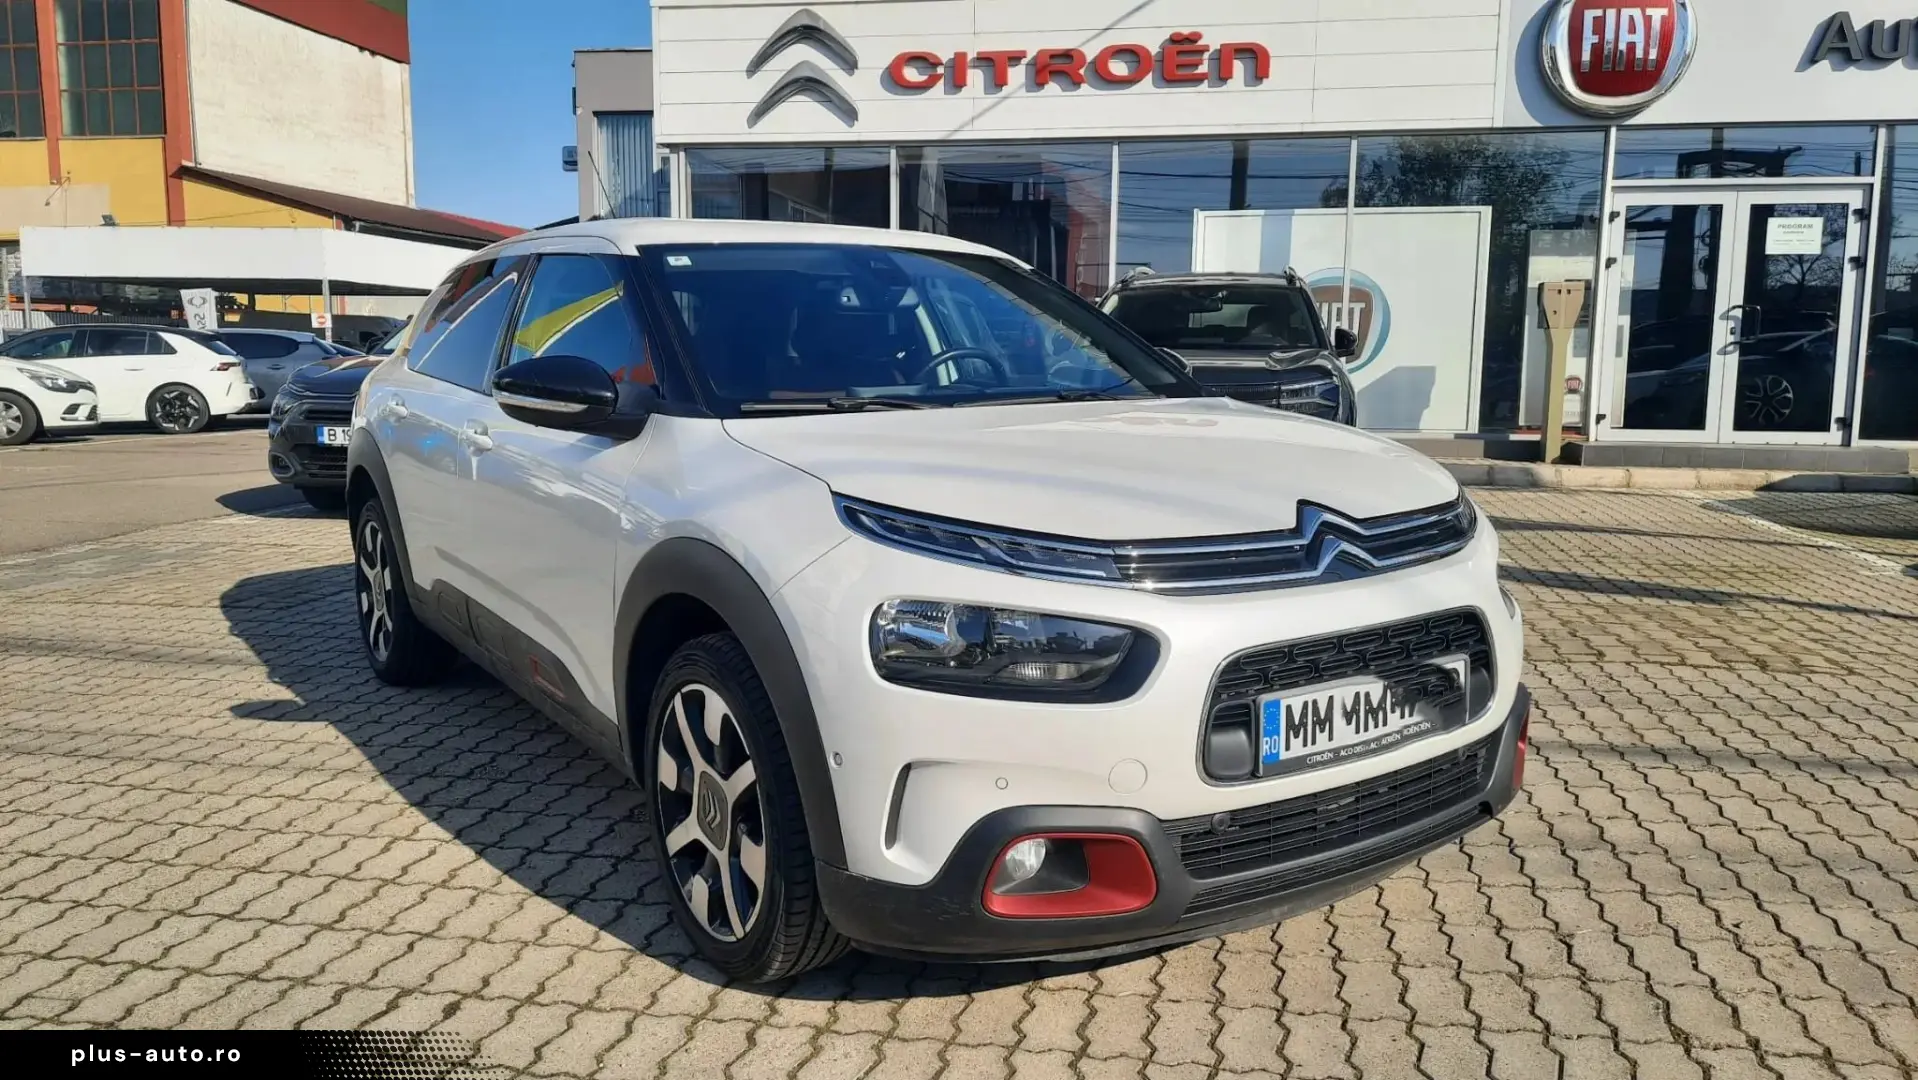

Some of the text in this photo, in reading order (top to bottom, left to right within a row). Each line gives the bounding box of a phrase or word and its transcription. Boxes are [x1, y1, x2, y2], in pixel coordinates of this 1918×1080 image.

[888, 31, 1271, 88] CITROËN
[1580, 8, 1669, 72] FIAT
[1811, 11, 1918, 60] Au
[327, 428, 337, 442] B
[1263, 735, 1279, 756] RO
